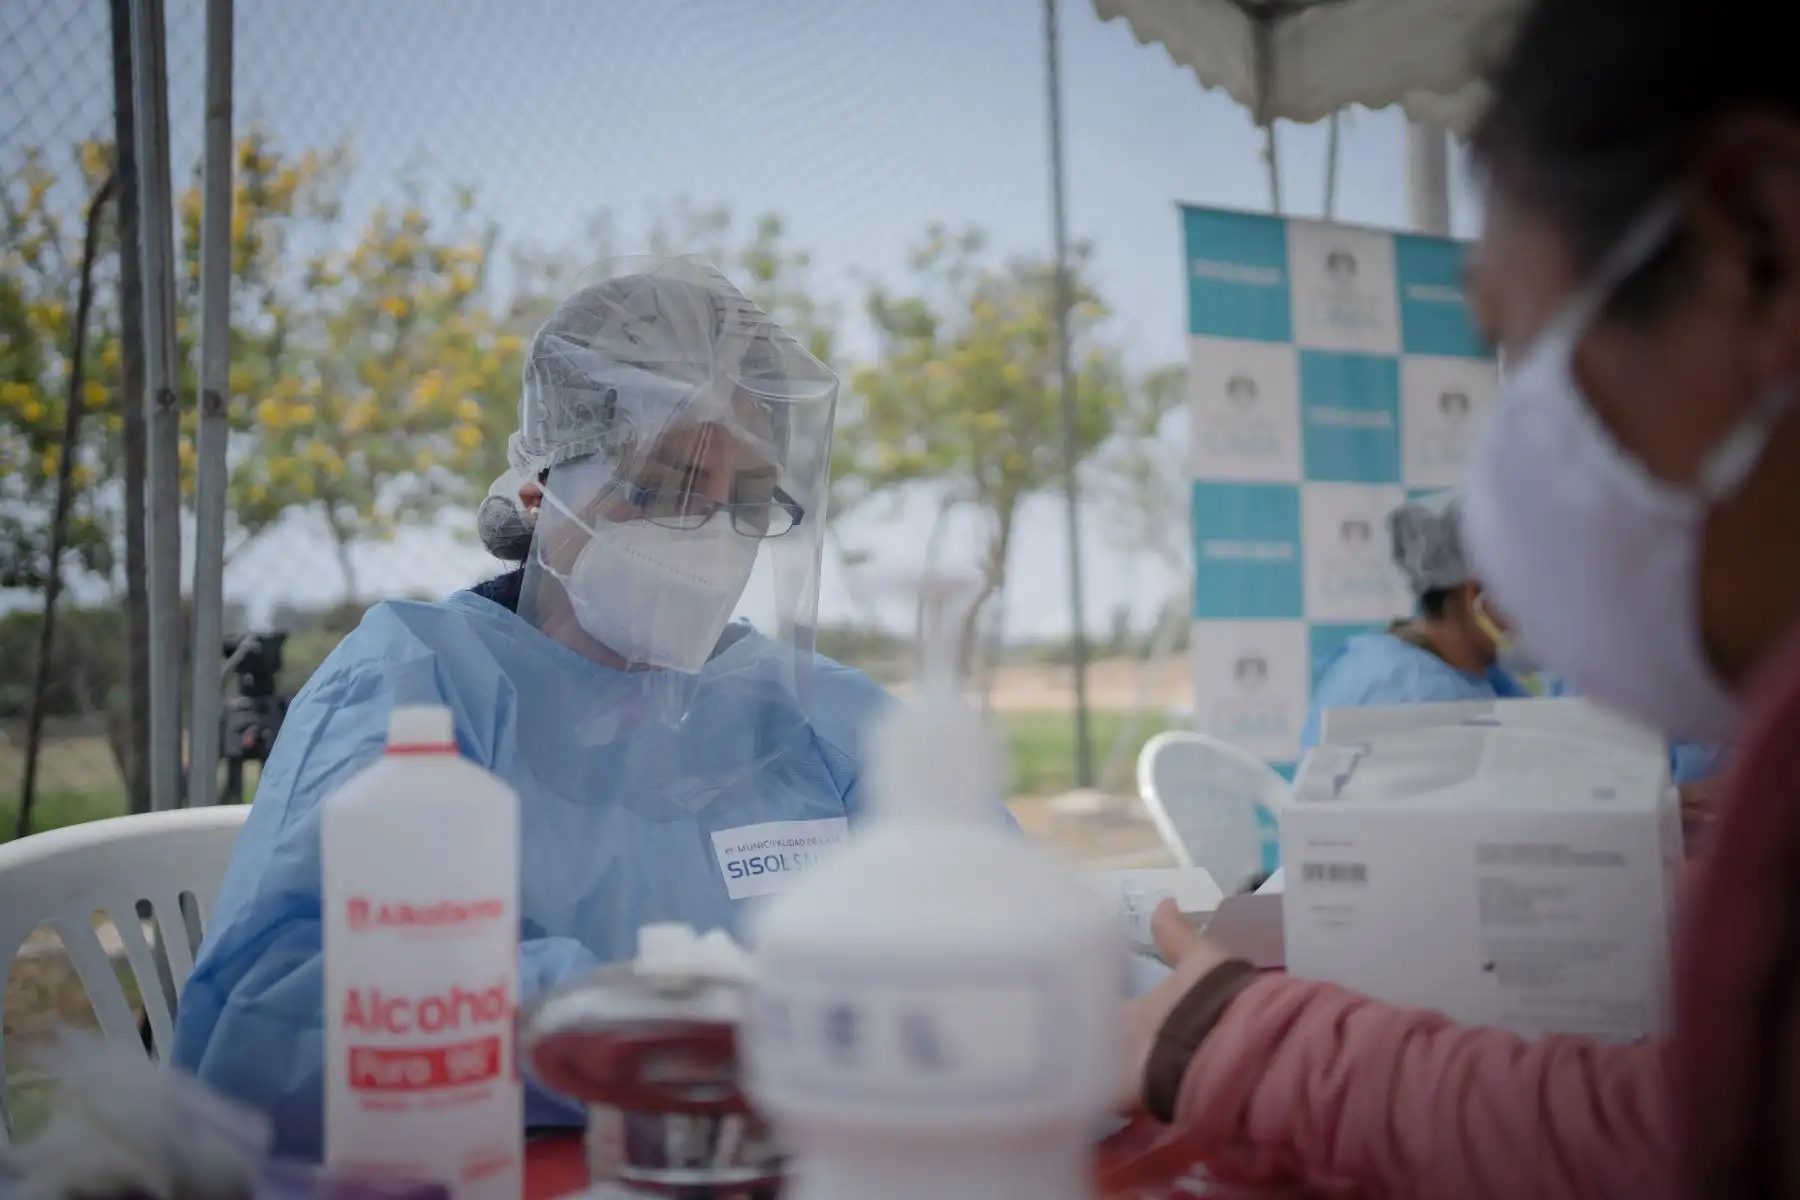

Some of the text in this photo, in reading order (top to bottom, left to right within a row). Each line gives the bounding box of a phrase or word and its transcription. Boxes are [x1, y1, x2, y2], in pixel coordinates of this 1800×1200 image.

[737, 836, 806, 854] MUNICIPALIDAD
[727, 853, 791, 879] SISOL
[343, 977, 508, 1035] Alcohol
